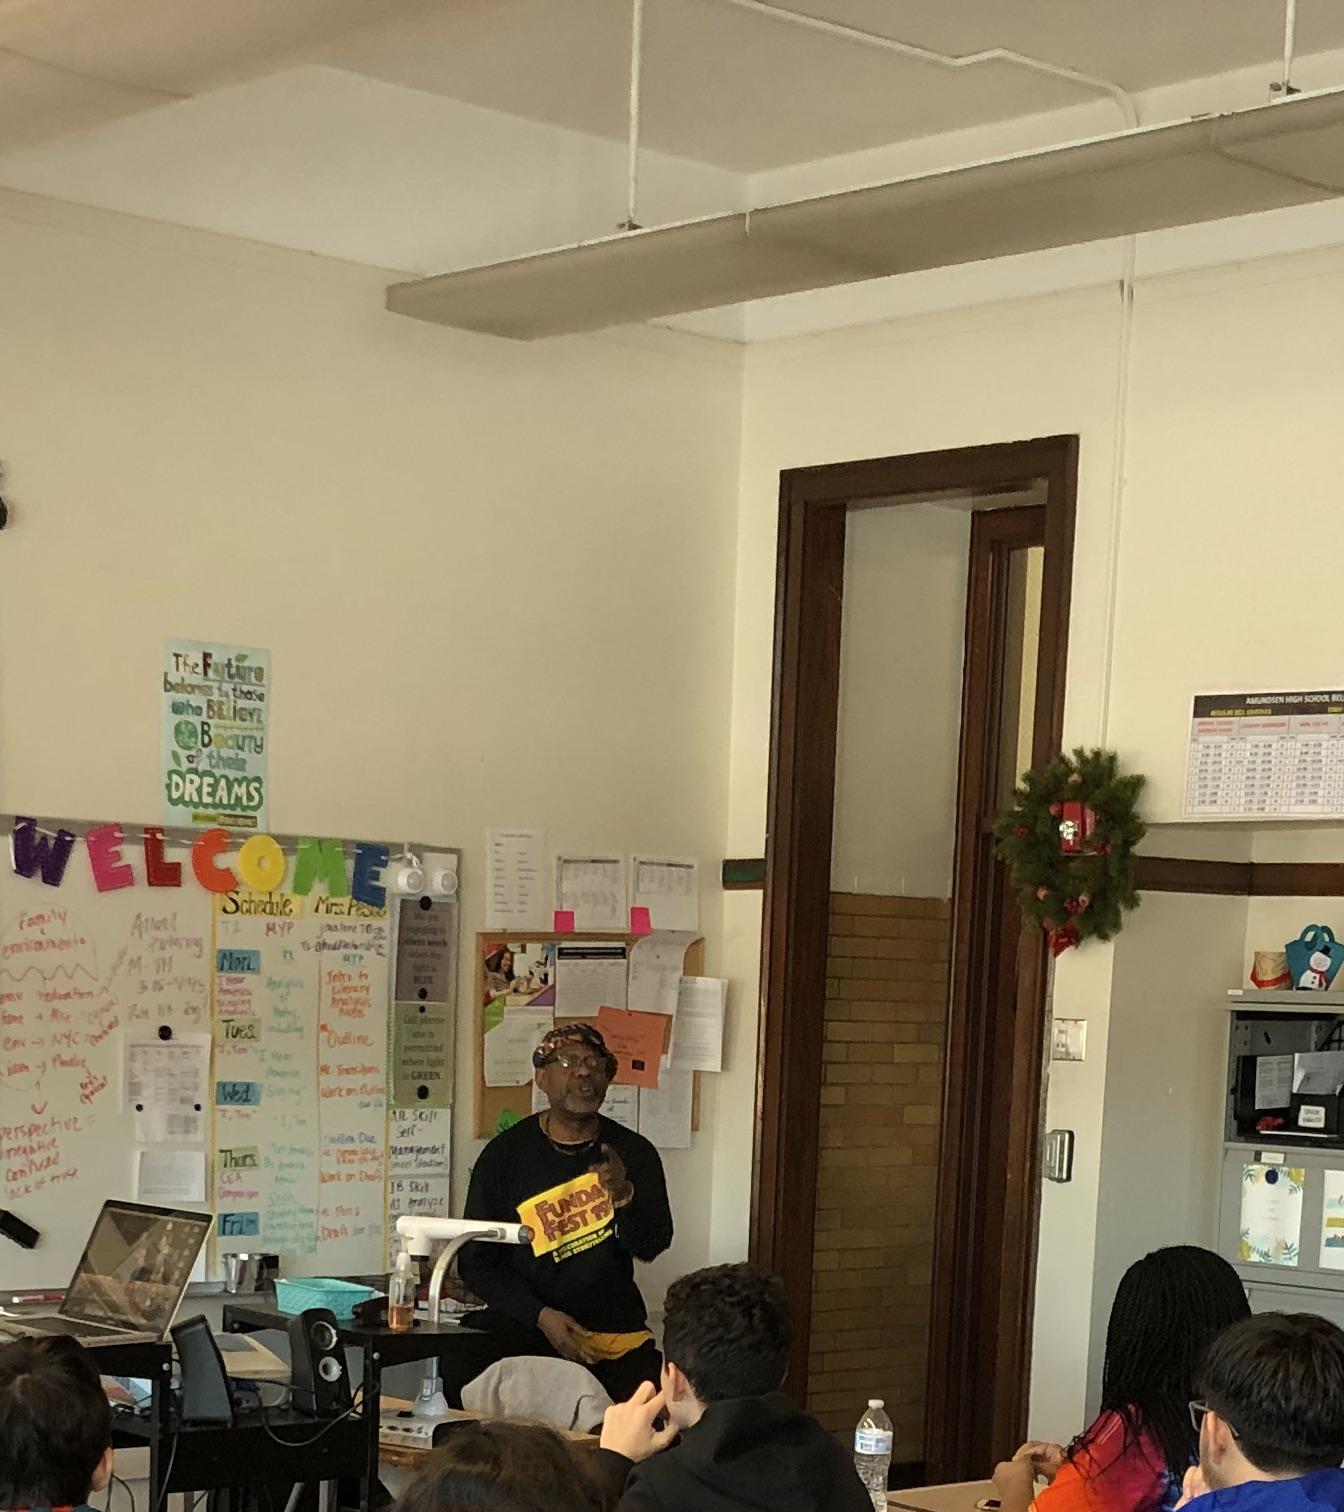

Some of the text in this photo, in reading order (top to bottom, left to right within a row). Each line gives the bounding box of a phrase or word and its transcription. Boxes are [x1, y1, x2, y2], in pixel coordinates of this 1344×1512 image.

[171, 651, 265, 683] The Future
[168, 770, 262, 808] DREAMS
[13, 816, 389, 907] WELCOME
[221, 890, 293, 917] Schedule
[411, 1070, 441, 1081] GREEN
